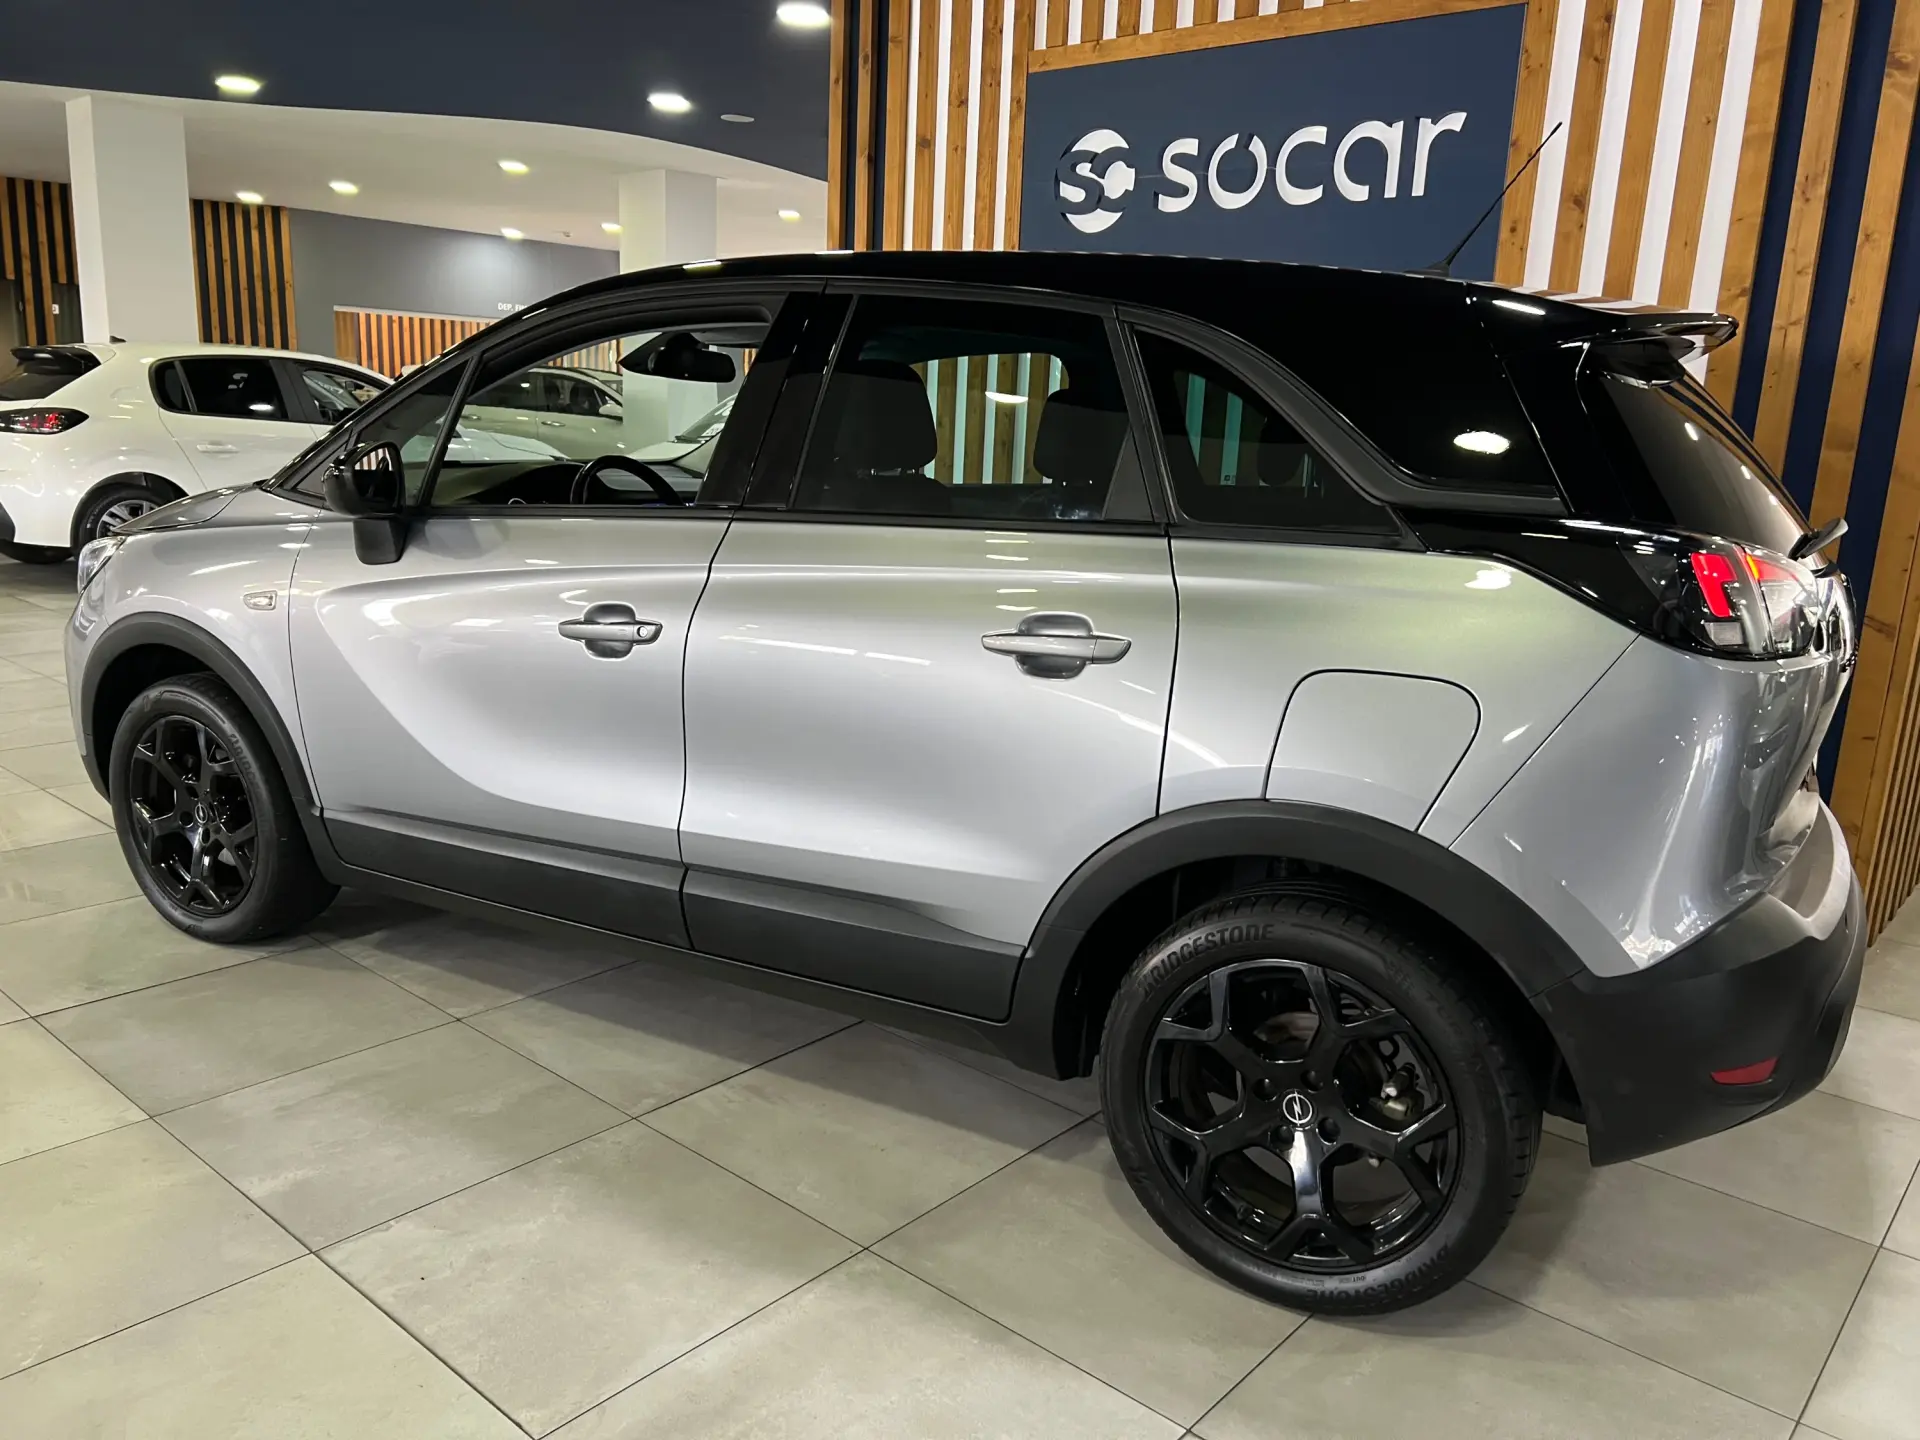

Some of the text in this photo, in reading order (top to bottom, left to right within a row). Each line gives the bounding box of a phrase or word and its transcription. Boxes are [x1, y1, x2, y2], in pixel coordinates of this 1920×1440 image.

[1156, 111, 1468, 213] socar
[498, 302, 514, 311] DEP.
[1136, 923, 1275, 997] BRIDGESTONE
